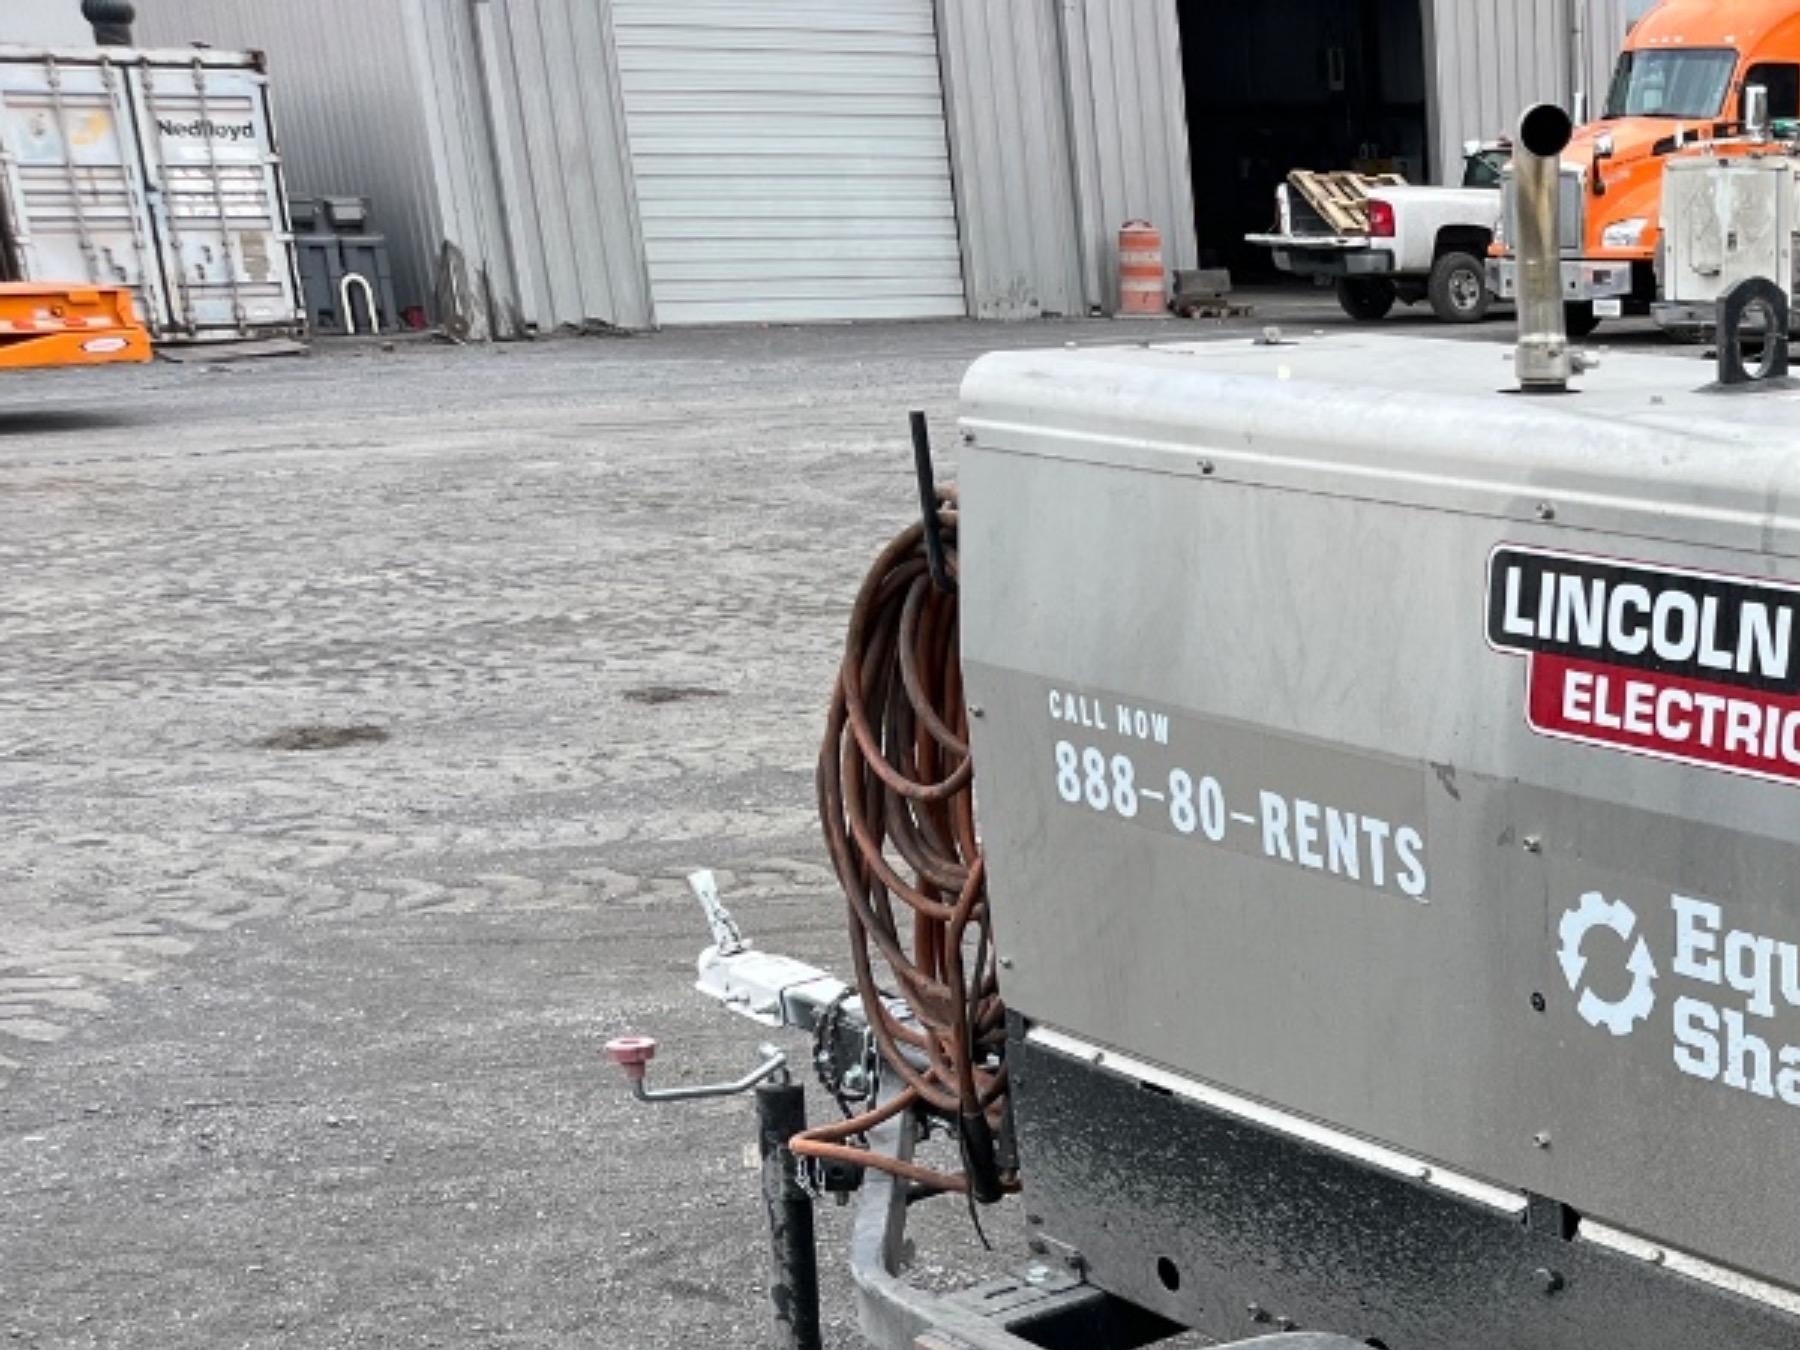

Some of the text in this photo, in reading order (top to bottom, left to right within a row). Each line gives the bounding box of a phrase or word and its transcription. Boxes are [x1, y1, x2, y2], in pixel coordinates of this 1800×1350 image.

[1503, 566, 1793, 679] LINCOLN
[1049, 689, 1169, 745] CALL NOW
[1055, 740, 1427, 896] 888-80-RENTS
